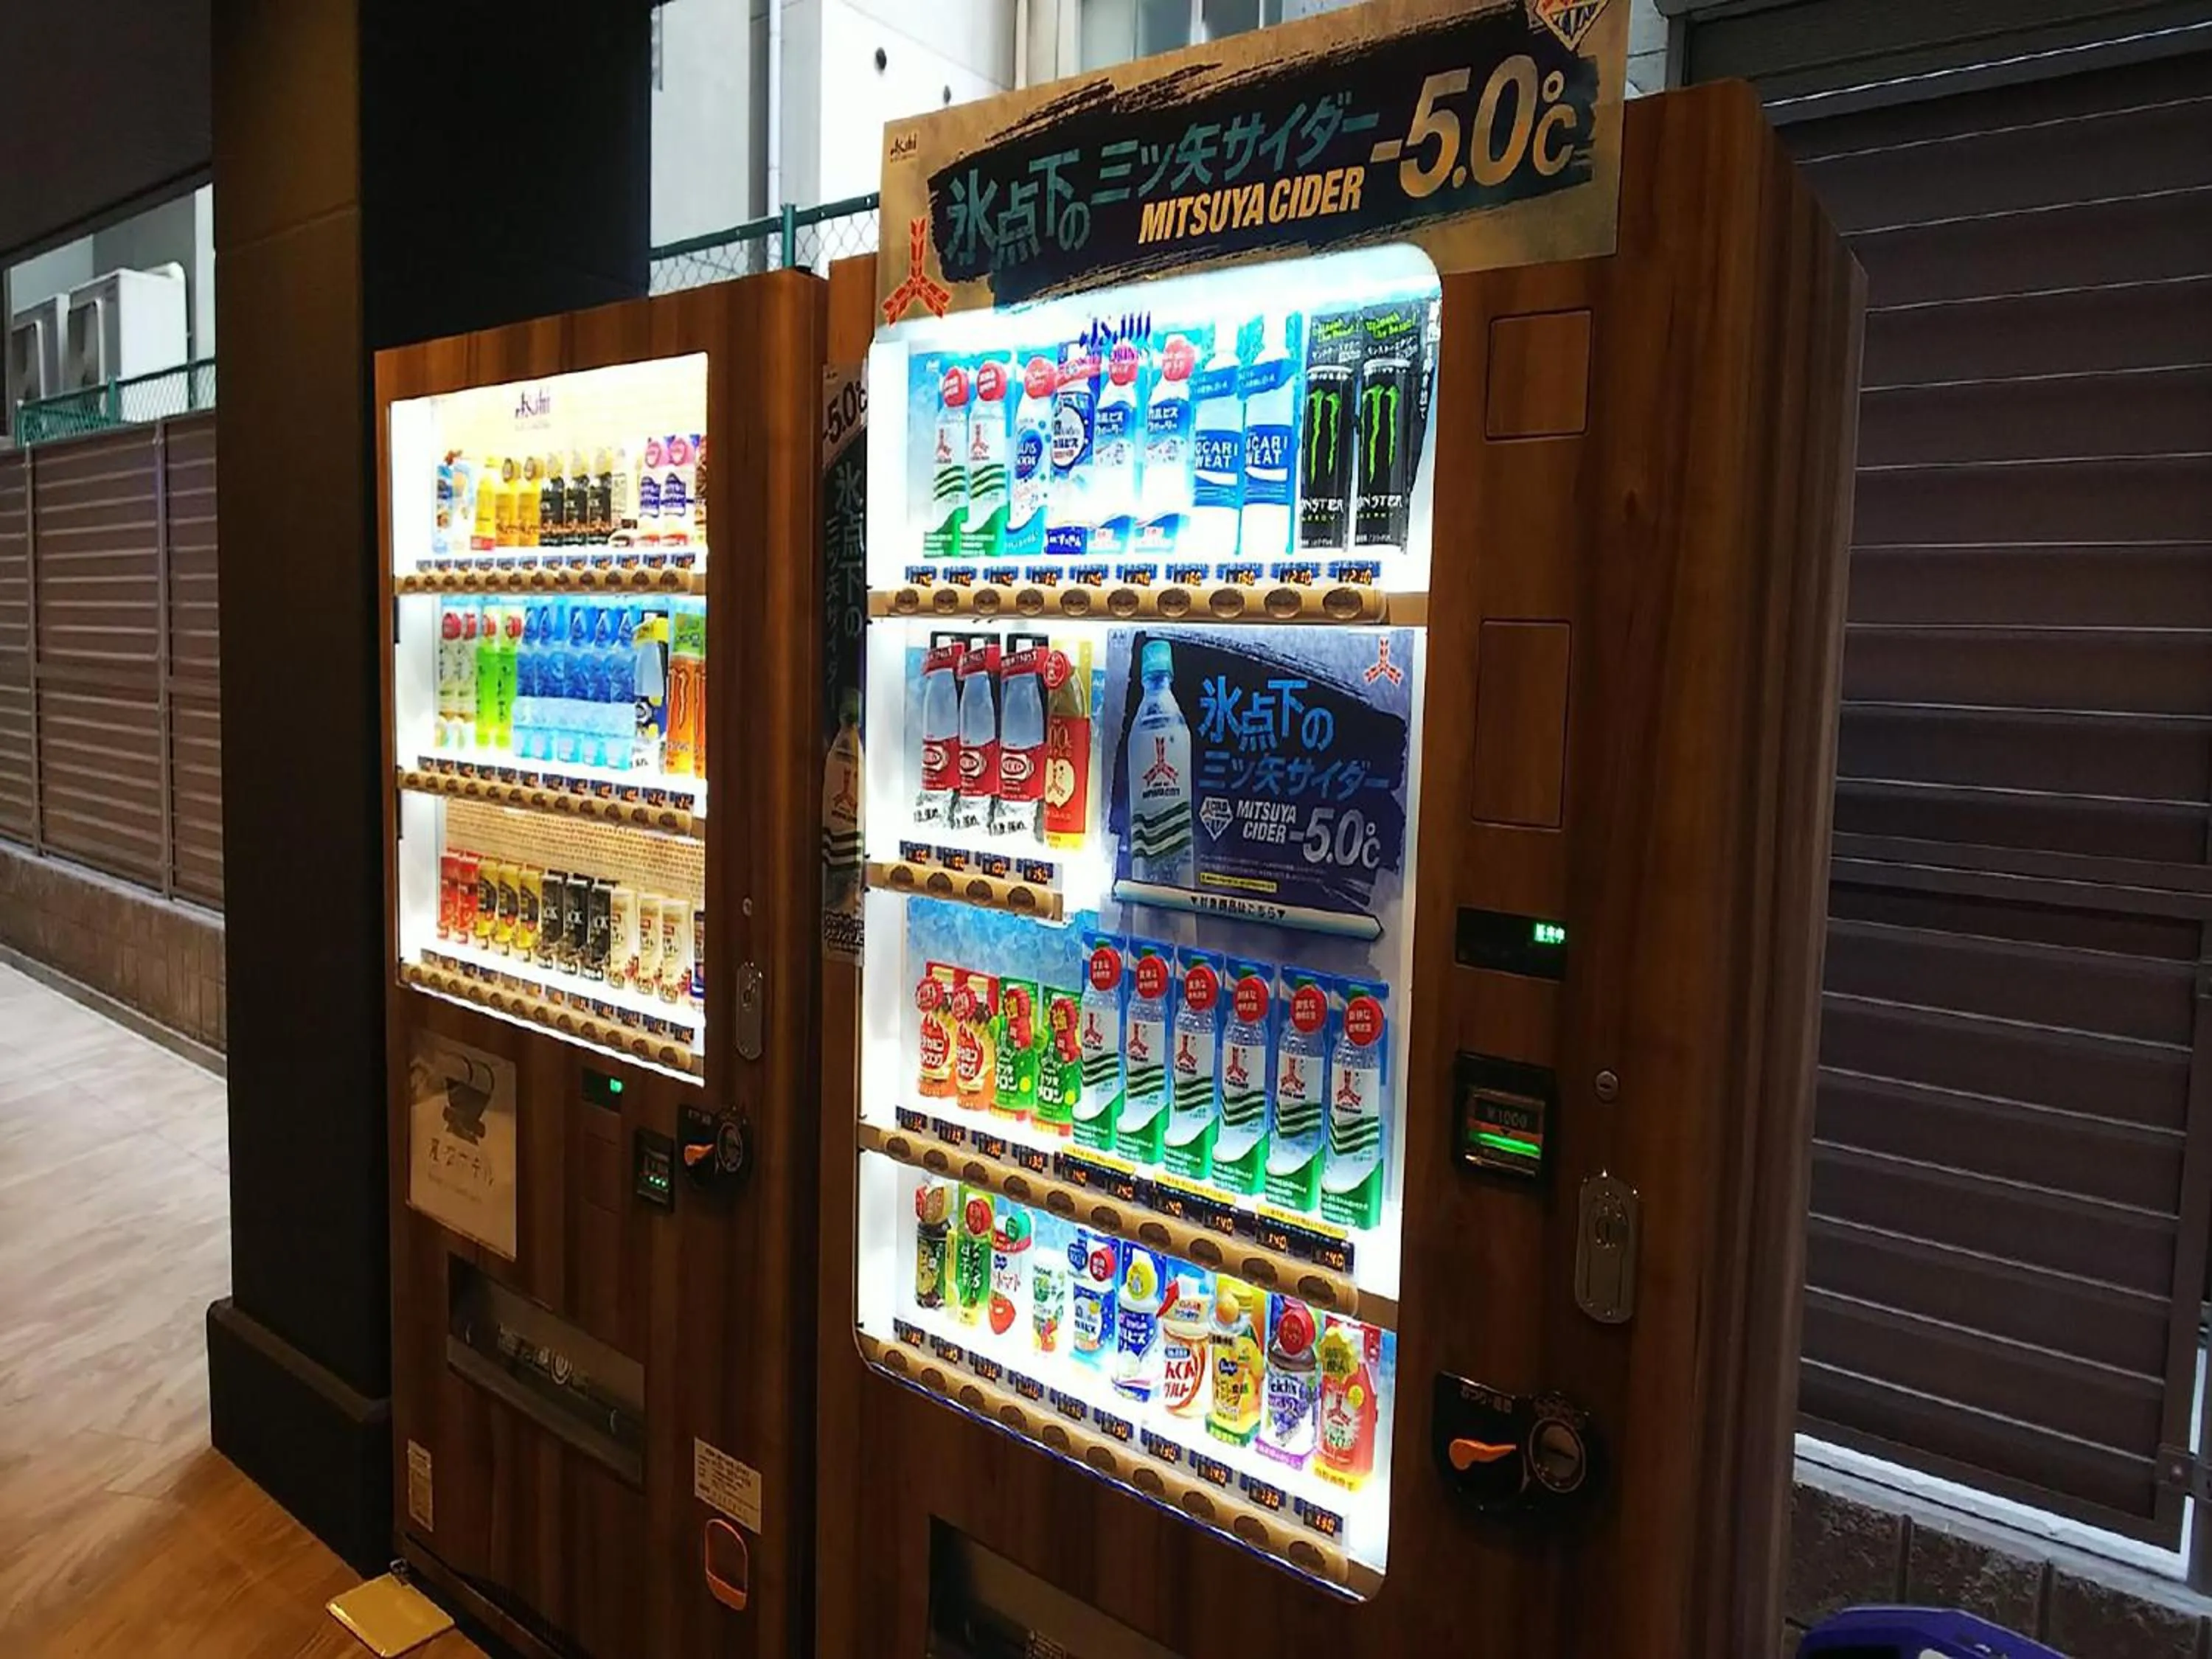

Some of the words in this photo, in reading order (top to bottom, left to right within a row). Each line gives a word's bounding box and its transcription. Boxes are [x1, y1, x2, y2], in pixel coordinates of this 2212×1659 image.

[946, 149, 1091, 265] 氷点下の
[1092, 95, 1379, 204] 三ツ矢サイダー
[1138, 181, 1267, 245] MITSUYA
[1269, 166, 1363, 222] CIDER
[1198, 675, 1335, 751] 氷点下の
[1198, 751, 1389, 801] 三ツ矢サイダー
[1237, 799, 1296, 823] MITSUYA
[1242, 821, 1286, 844] CIDER
